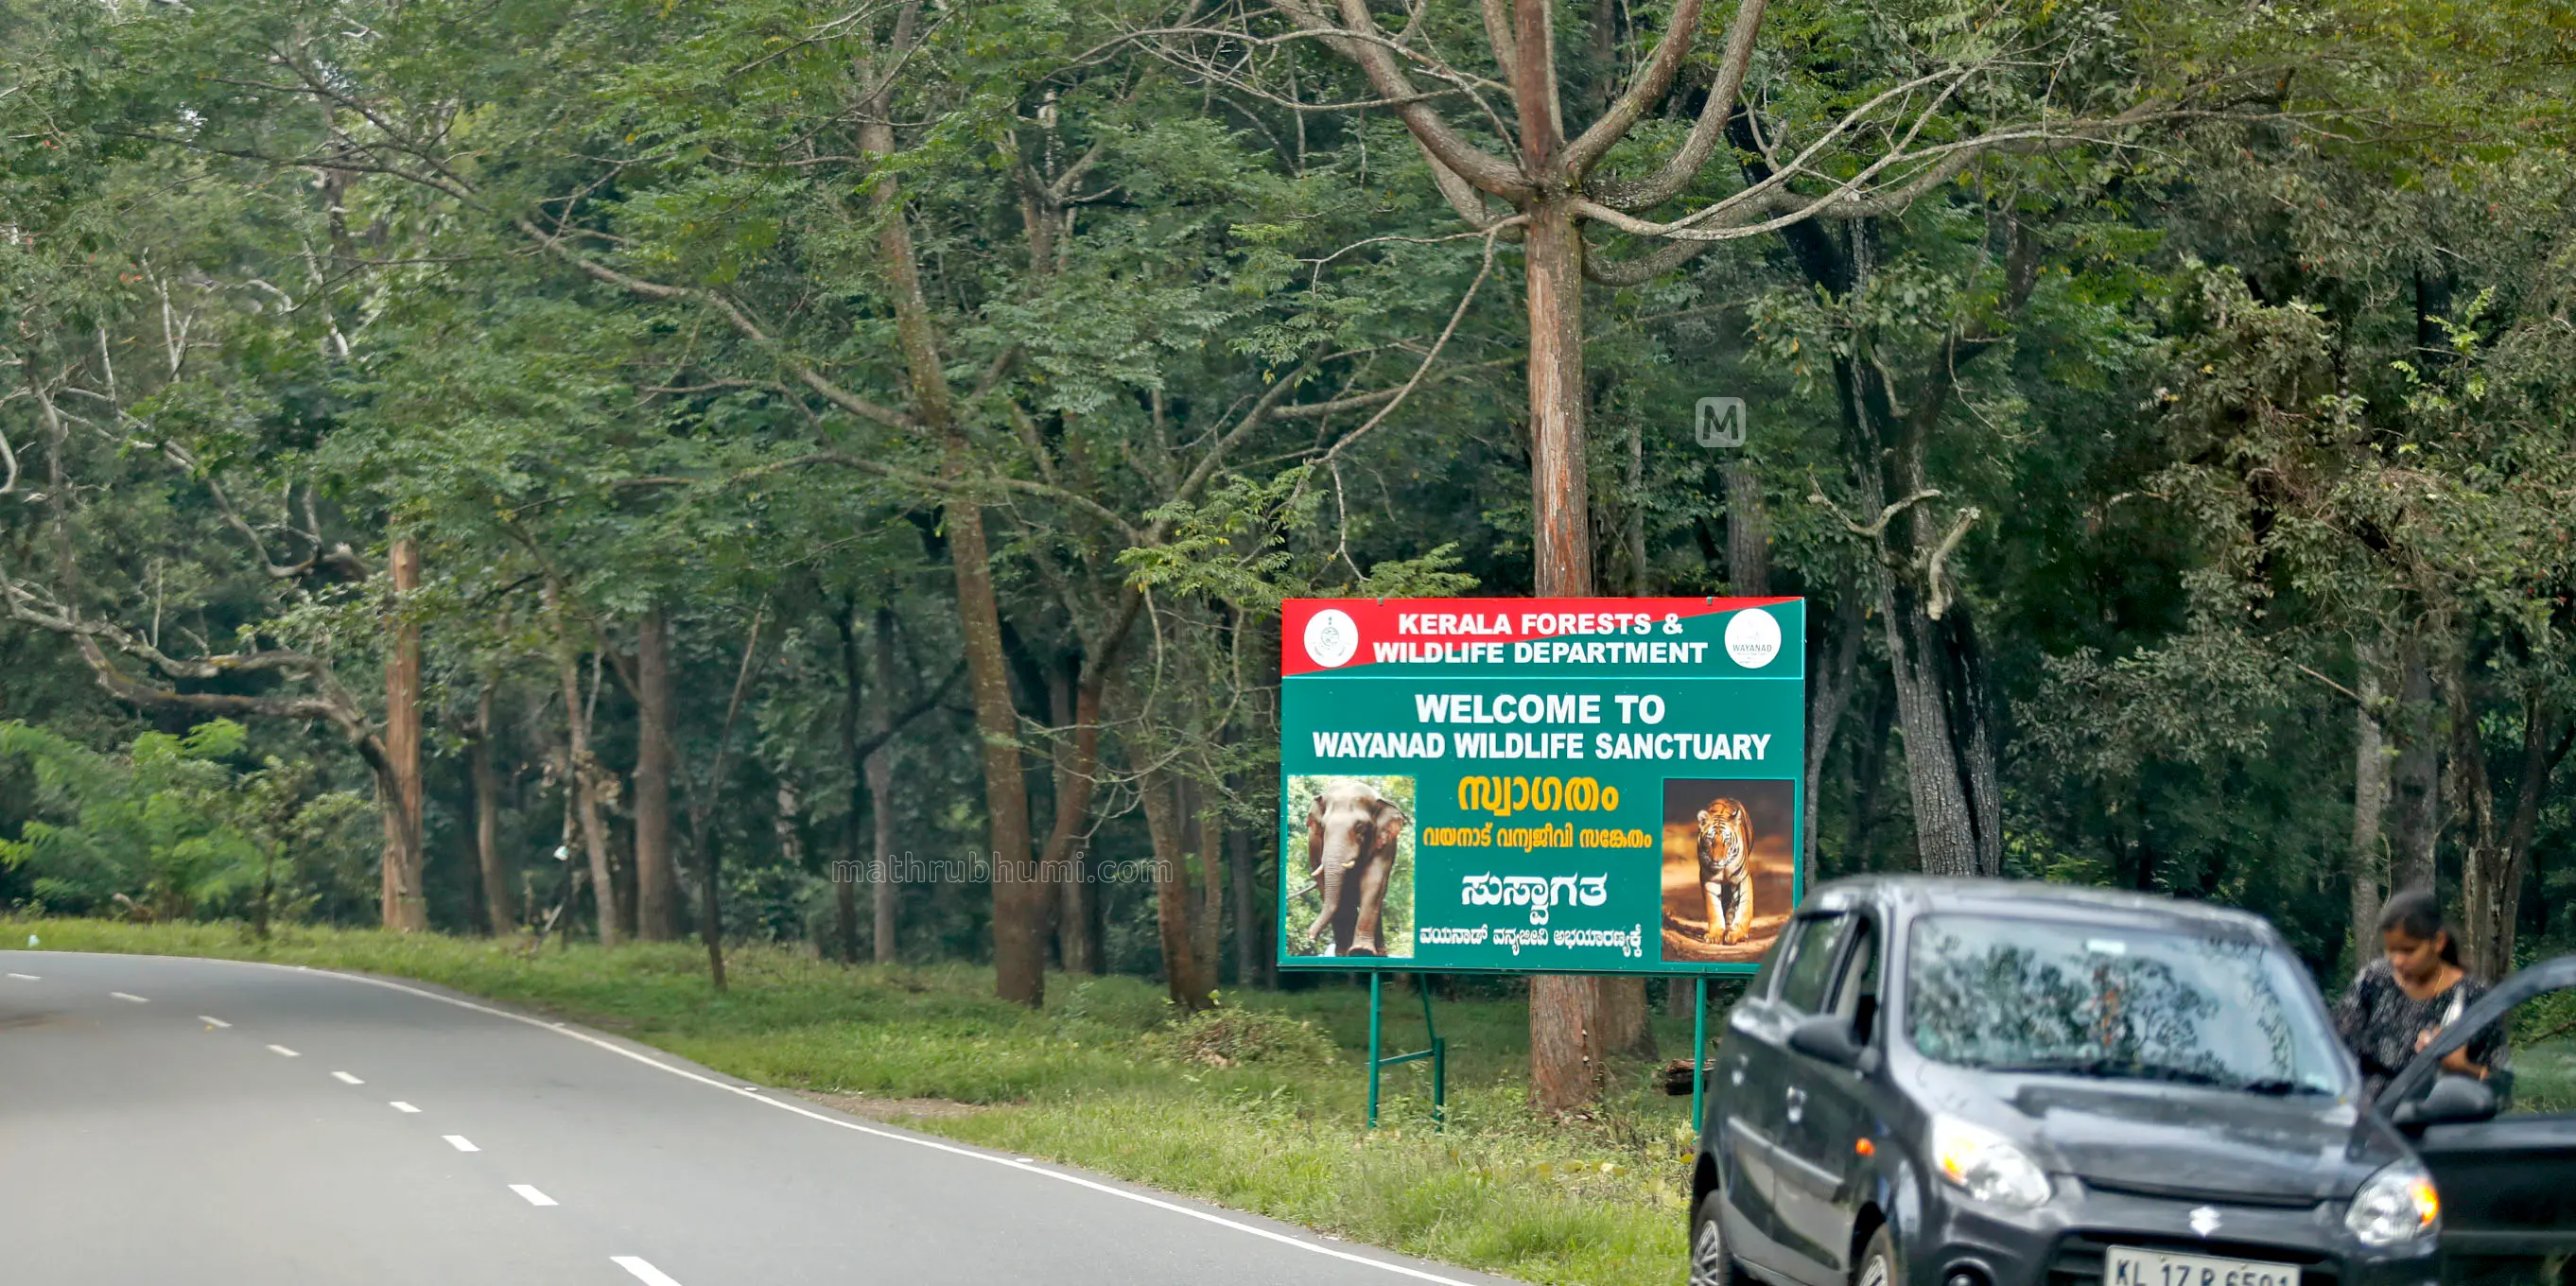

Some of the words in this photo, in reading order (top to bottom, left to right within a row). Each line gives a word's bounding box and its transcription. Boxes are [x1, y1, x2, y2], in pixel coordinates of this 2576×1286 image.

[1399, 614, 1512, 635] KERALA
[1521, 614, 1651, 635] FORESTS
[1662, 614, 1684, 634] &
[1373, 643, 1504, 664] WILDLIFE
[1514, 643, 1708, 664] DEPARTMENT
[1732, 644, 1772, 652] WAYANAD
[1415, 694, 1600, 724] WELCOME
[1614, 695, 1665, 724] TO
[1313, 732, 1445, 758] WAYANAD
[1453, 733, 1583, 758] WILDLIFE
[1594, 733, 1770, 760] SANCTUARY
[1457, 775, 1619, 816] സ്വാഗതം
[1422, 822, 1493, 846] വയനാട്
[1496, 822, 1574, 853] വന്യജീവി
[1579, 828, 1653, 848] സങ്കേതം
[1461, 870, 1608, 925] ಸುಸ್ವಾಗತ
[1419, 923, 1488, 945] ವಯನಾಡ್
[1492, 927, 1549, 956] ವನ್ಯಜೀವಿ
[2115, 1259, 2147, 1286] KL
